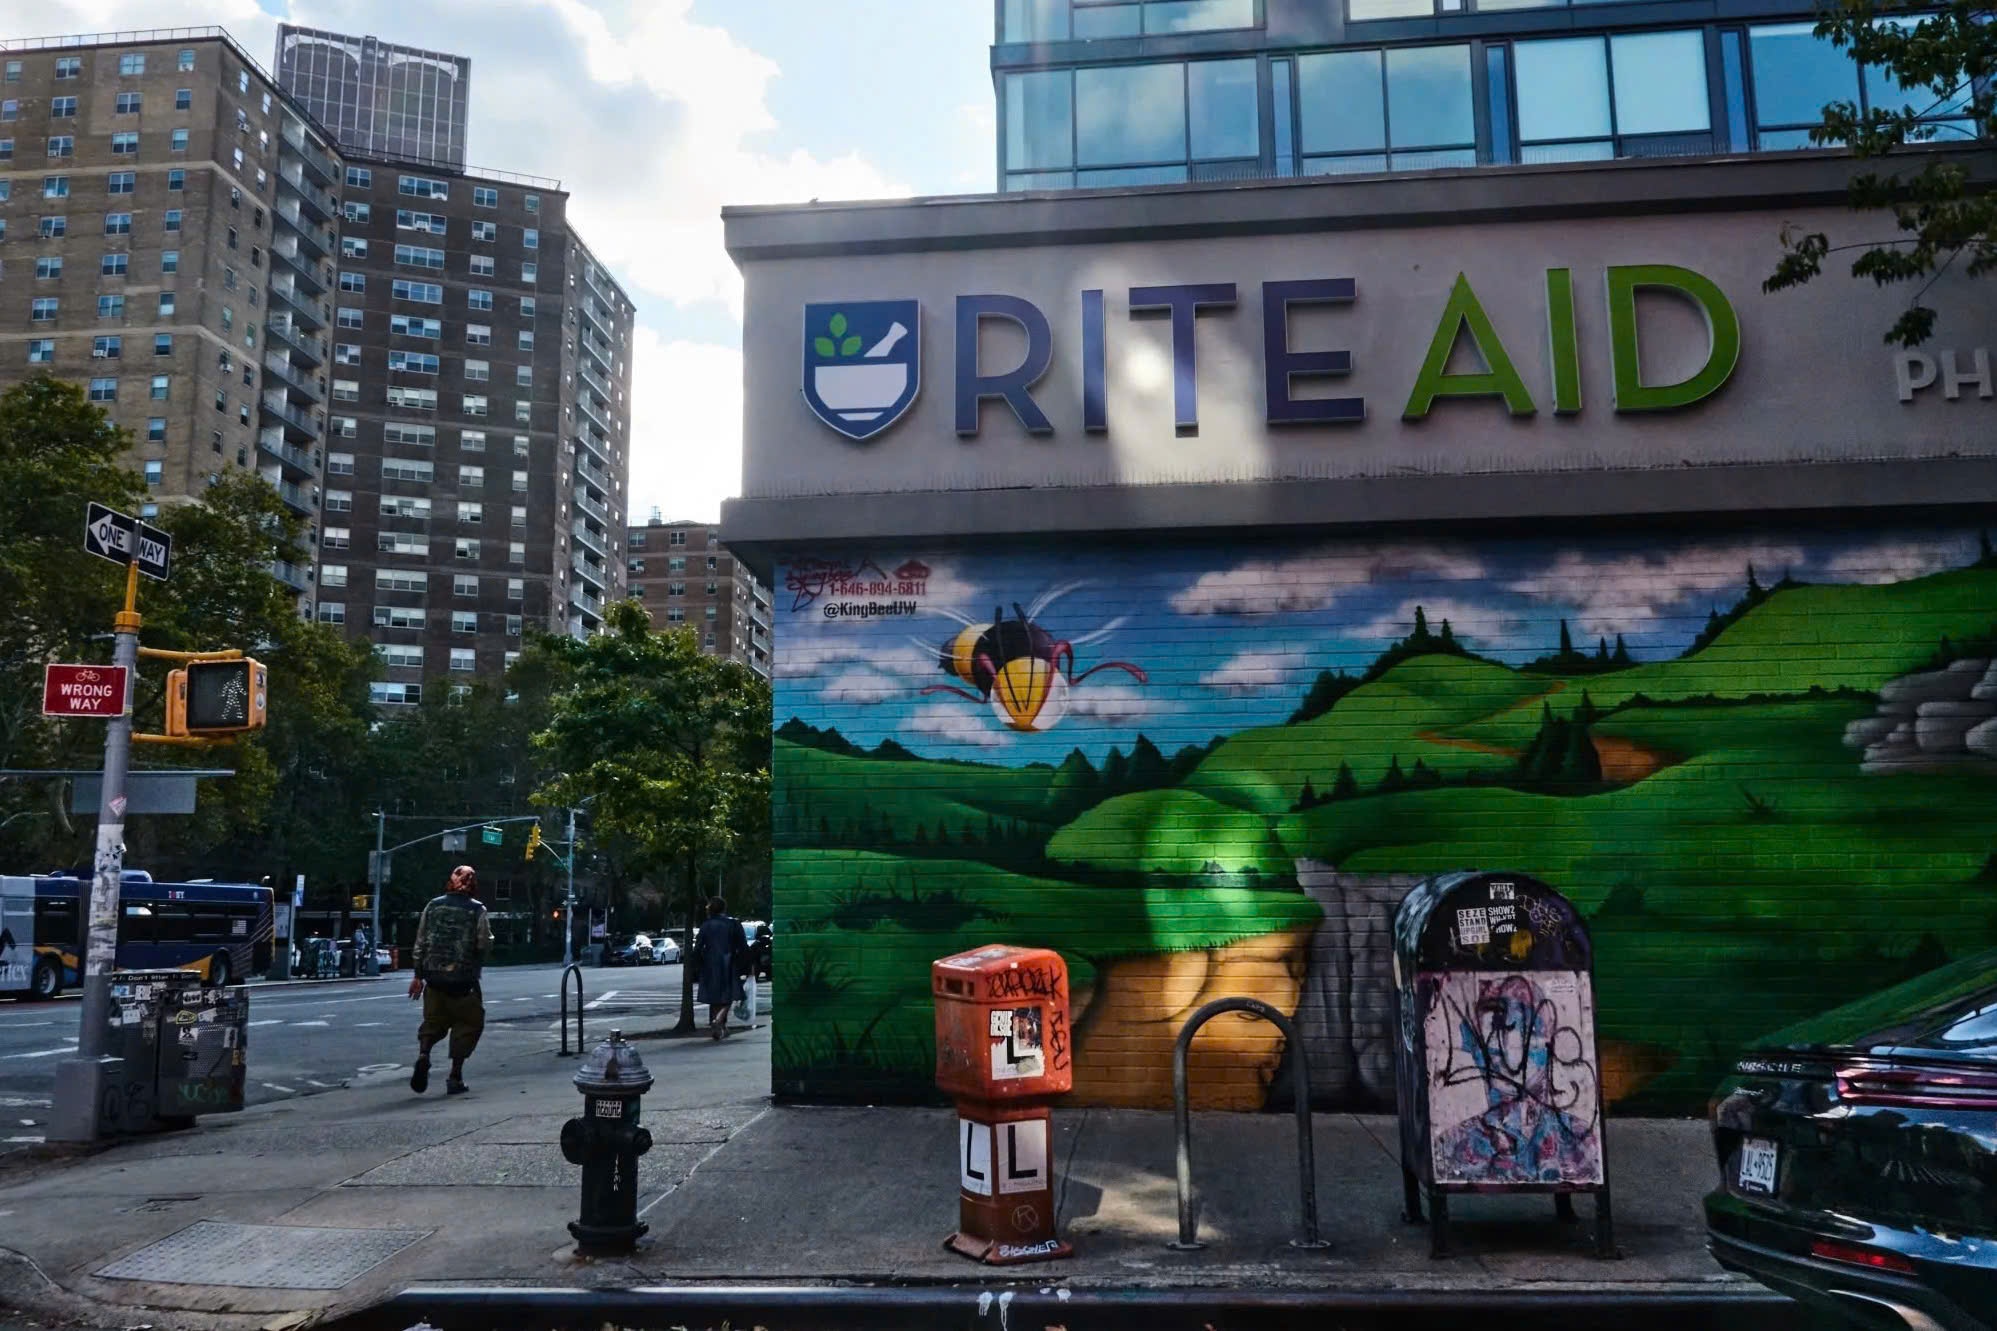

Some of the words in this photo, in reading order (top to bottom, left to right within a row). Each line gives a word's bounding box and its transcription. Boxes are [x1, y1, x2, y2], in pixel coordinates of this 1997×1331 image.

[954, 277, 1367, 438] RITE
[1402, 263, 1741, 421] AID
[99, 523, 125, 548] ONE
[829, 581, 927, 597] 1-646-894-6811
[823, 600, 917, 619] @KingBeeUW
[60, 683, 113, 697] WRONG
[69, 697, 103, 711] WAY
[1458, 909, 1485, 919] SEZE
[1459, 917, 1486, 927] STAND
[966, 1122, 985, 1181] L
[1008, 1124, 1038, 1180] L
